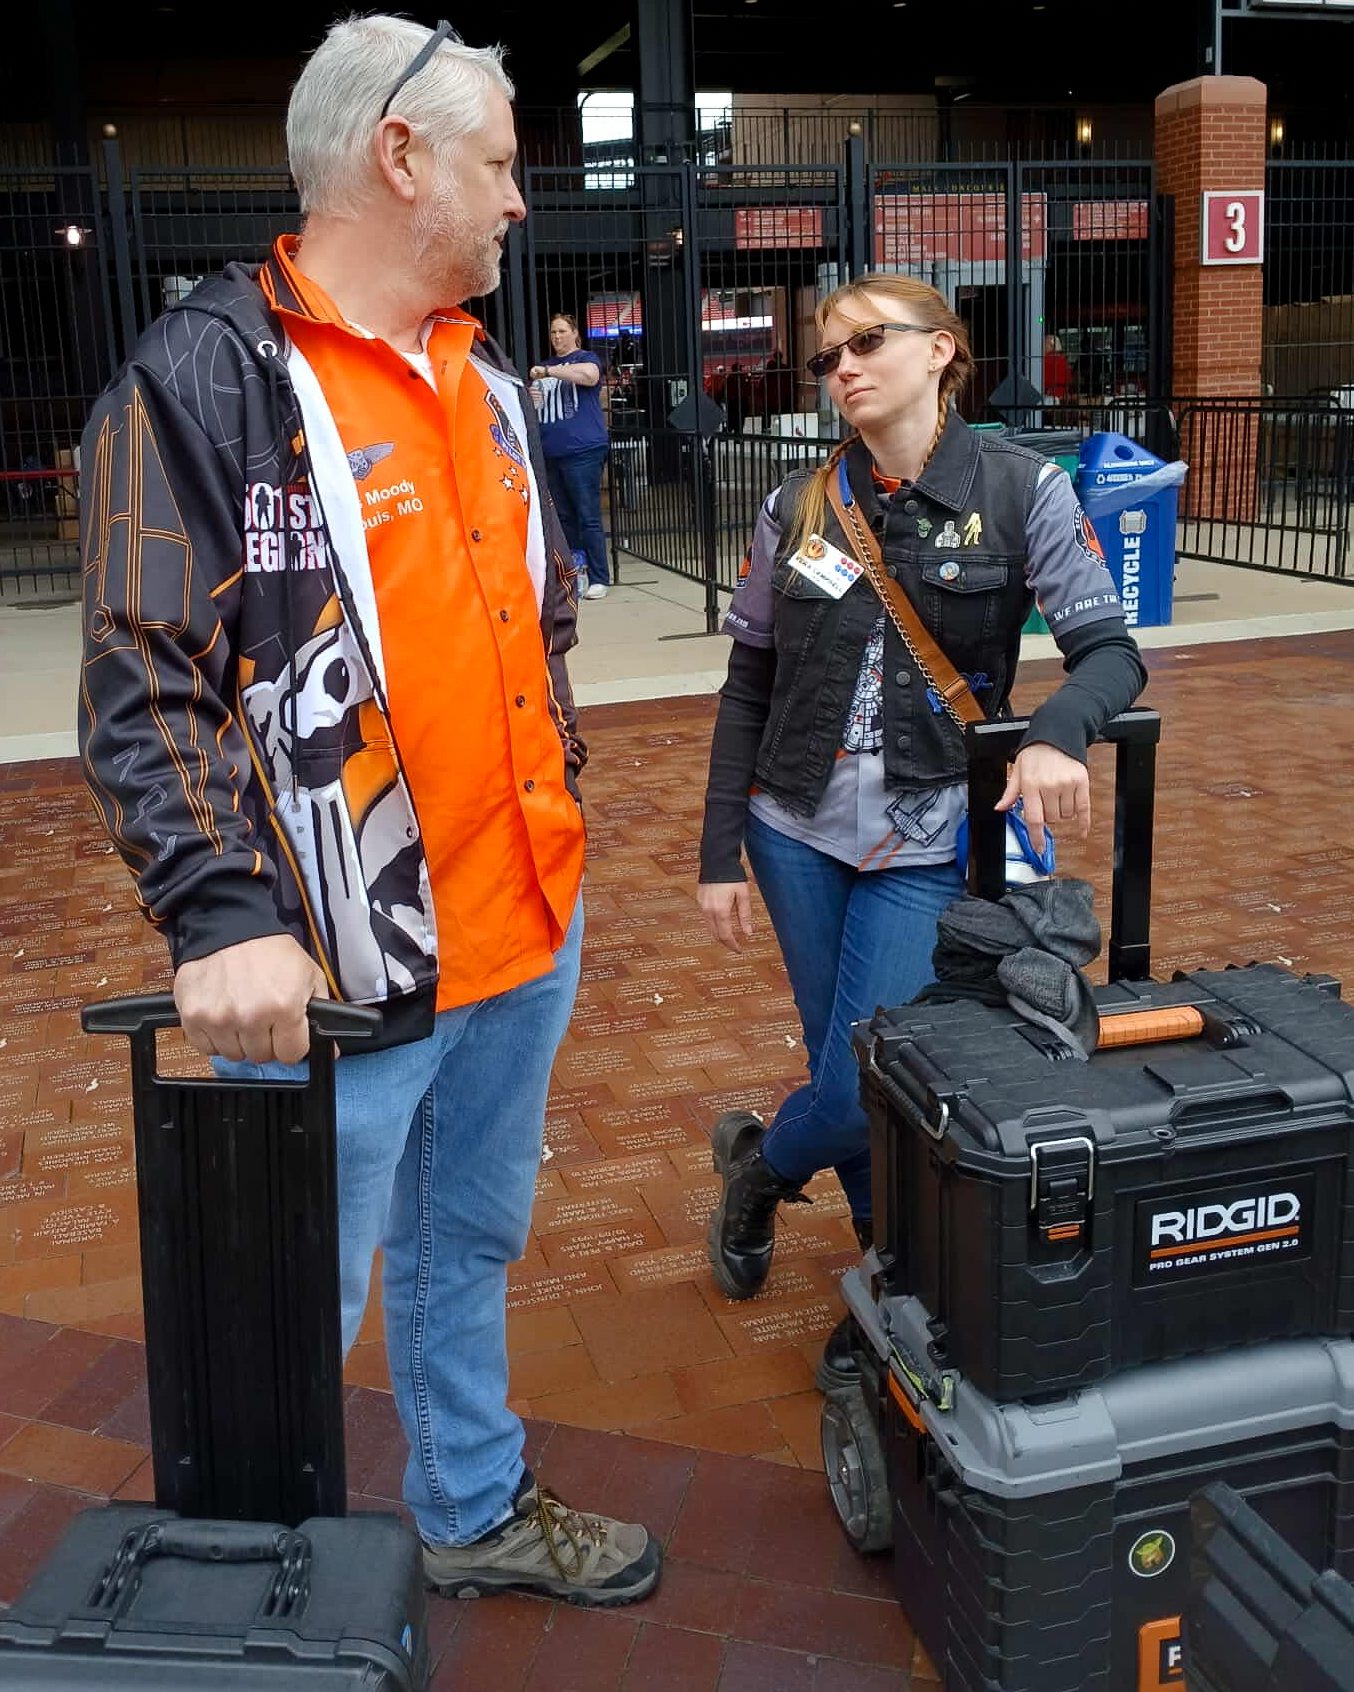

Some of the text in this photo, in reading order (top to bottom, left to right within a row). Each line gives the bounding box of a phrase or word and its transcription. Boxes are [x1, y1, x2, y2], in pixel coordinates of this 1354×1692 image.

[1224, 202, 1246, 252] 3
[364, 479, 416, 506] Moody
[361, 497, 424, 530] ouis, MO
[244, 530, 327, 573] EGION
[1122, 535, 1142, 626] RECYCLE
[1053, 606, 1072, 621] WE
[1075, 596, 1101, 612] ARE
[1150, 1192, 1301, 1246] RIDGID
[1149, 1237, 1300, 1272] PRO GEAR SYSTEM GEN 2.0
[574, 1284, 603, 1297] JOHN
